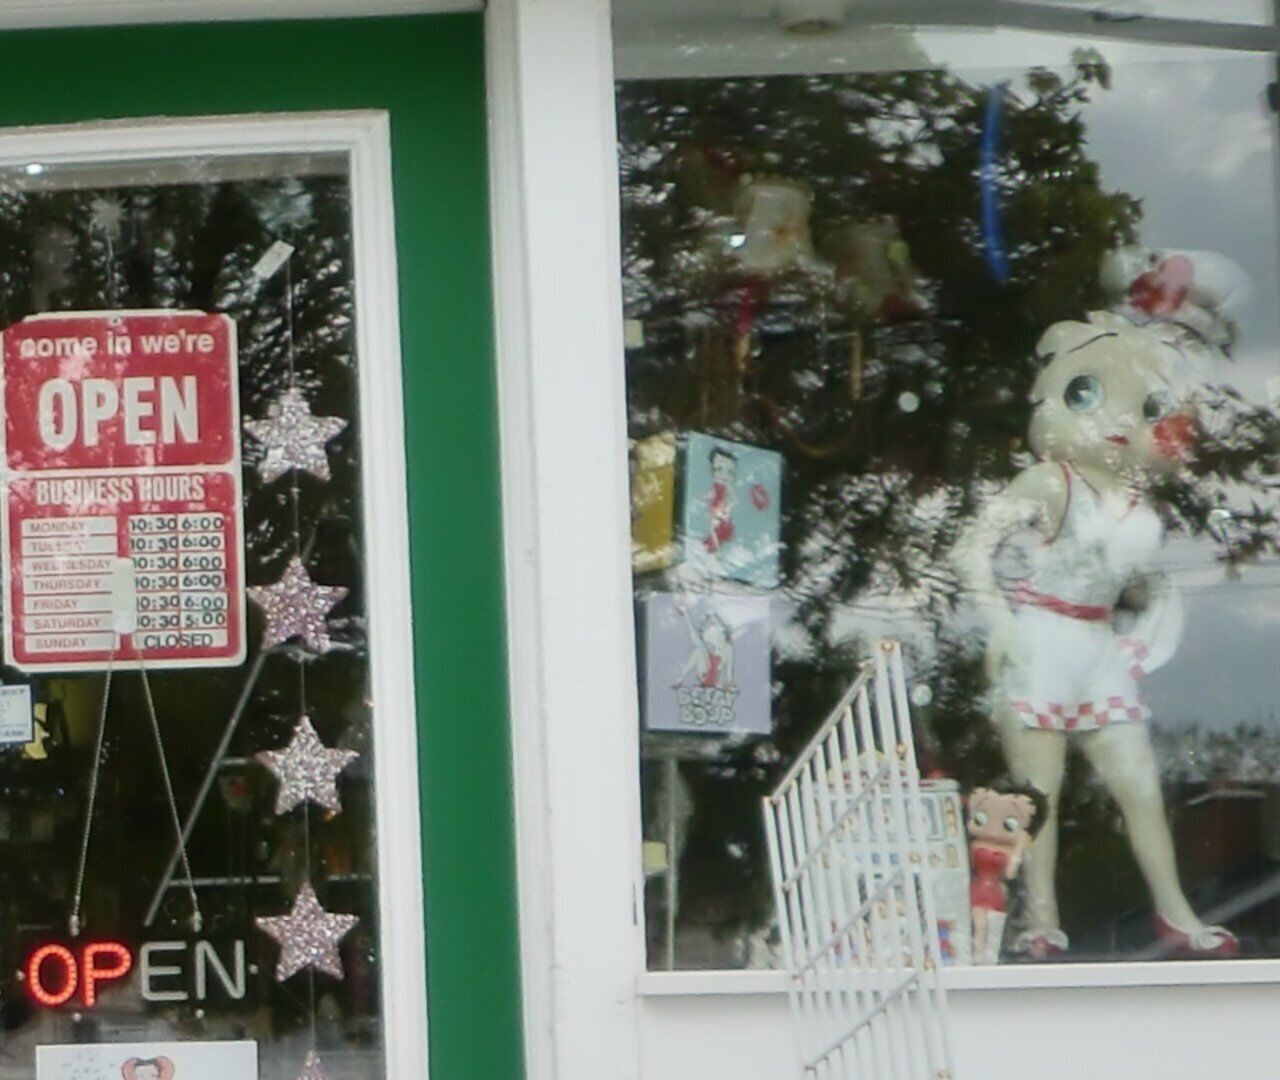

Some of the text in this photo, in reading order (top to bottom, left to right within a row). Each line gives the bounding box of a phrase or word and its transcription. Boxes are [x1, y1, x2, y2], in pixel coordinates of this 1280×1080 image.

[107, 330, 132, 355] in
[141, 328, 215, 354] we're
[37, 374, 200, 449] OPEN
[36, 475, 206, 506] BUSINESS HOURS
[30, 516, 224, 534] MONDAY 10:30 6:00
[130, 536, 179, 551] 10:30
[181, 535, 222, 549] 6:00
[132, 556, 180, 569] 10:30
[182, 555, 222, 569] 6:00
[32, 574, 222, 591] THURSDAY 10:30 6:00
[32, 598, 80, 610] FRIDAY
[183, 595, 225, 611] 6:00
[33, 617, 102, 630] SATURDAY
[184, 611, 226, 628] 5:00
[35, 632, 214, 649] SUNDAY CLOSED
[26, 938, 247, 1008] OPEN
